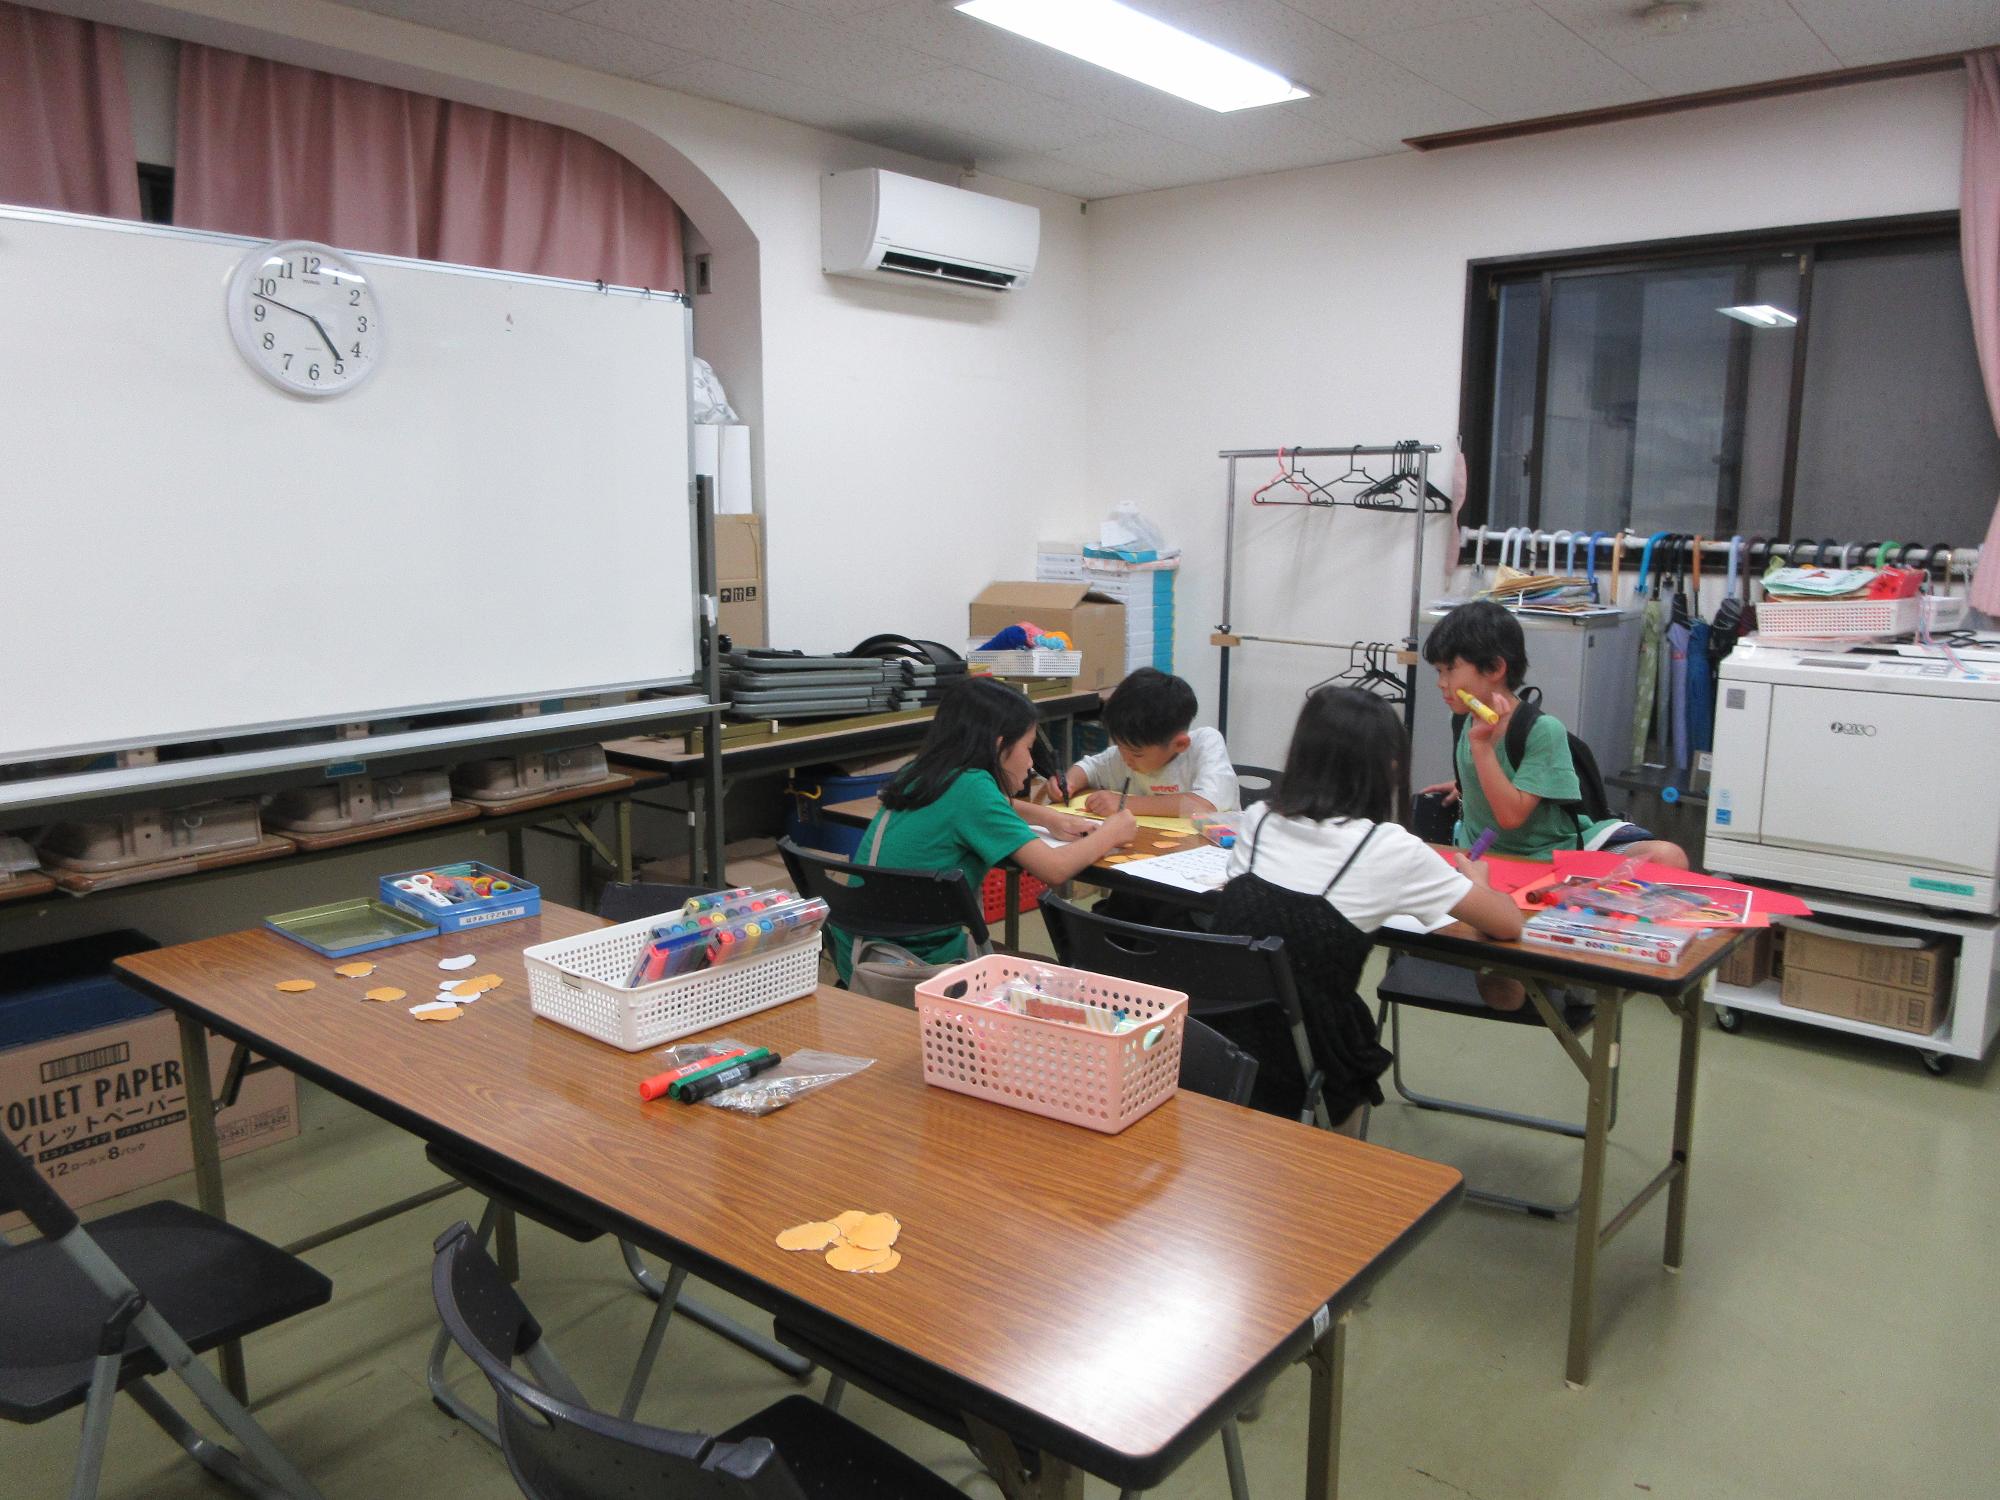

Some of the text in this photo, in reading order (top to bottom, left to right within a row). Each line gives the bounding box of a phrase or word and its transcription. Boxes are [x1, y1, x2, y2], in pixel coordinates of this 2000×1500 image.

[278, 262, 294, 279] 11
[302, 257, 321, 275] 12
[258, 278, 277, 296] 10
[349, 289, 361, 307] 2
[254, 304, 266, 322] 9
[357, 316, 368, 333] 3
[263, 332, 275, 350] 8
[351, 341, 361, 358] 4
[282, 353, 294, 370] 7
[334, 358, 344, 375] 5
[309, 363, 320, 381] 6
[0, 1085, 82, 1131] OILET
[95, 1060, 183, 1107] PAPER
[16, 1094, 186, 1153] イレットペーパー
